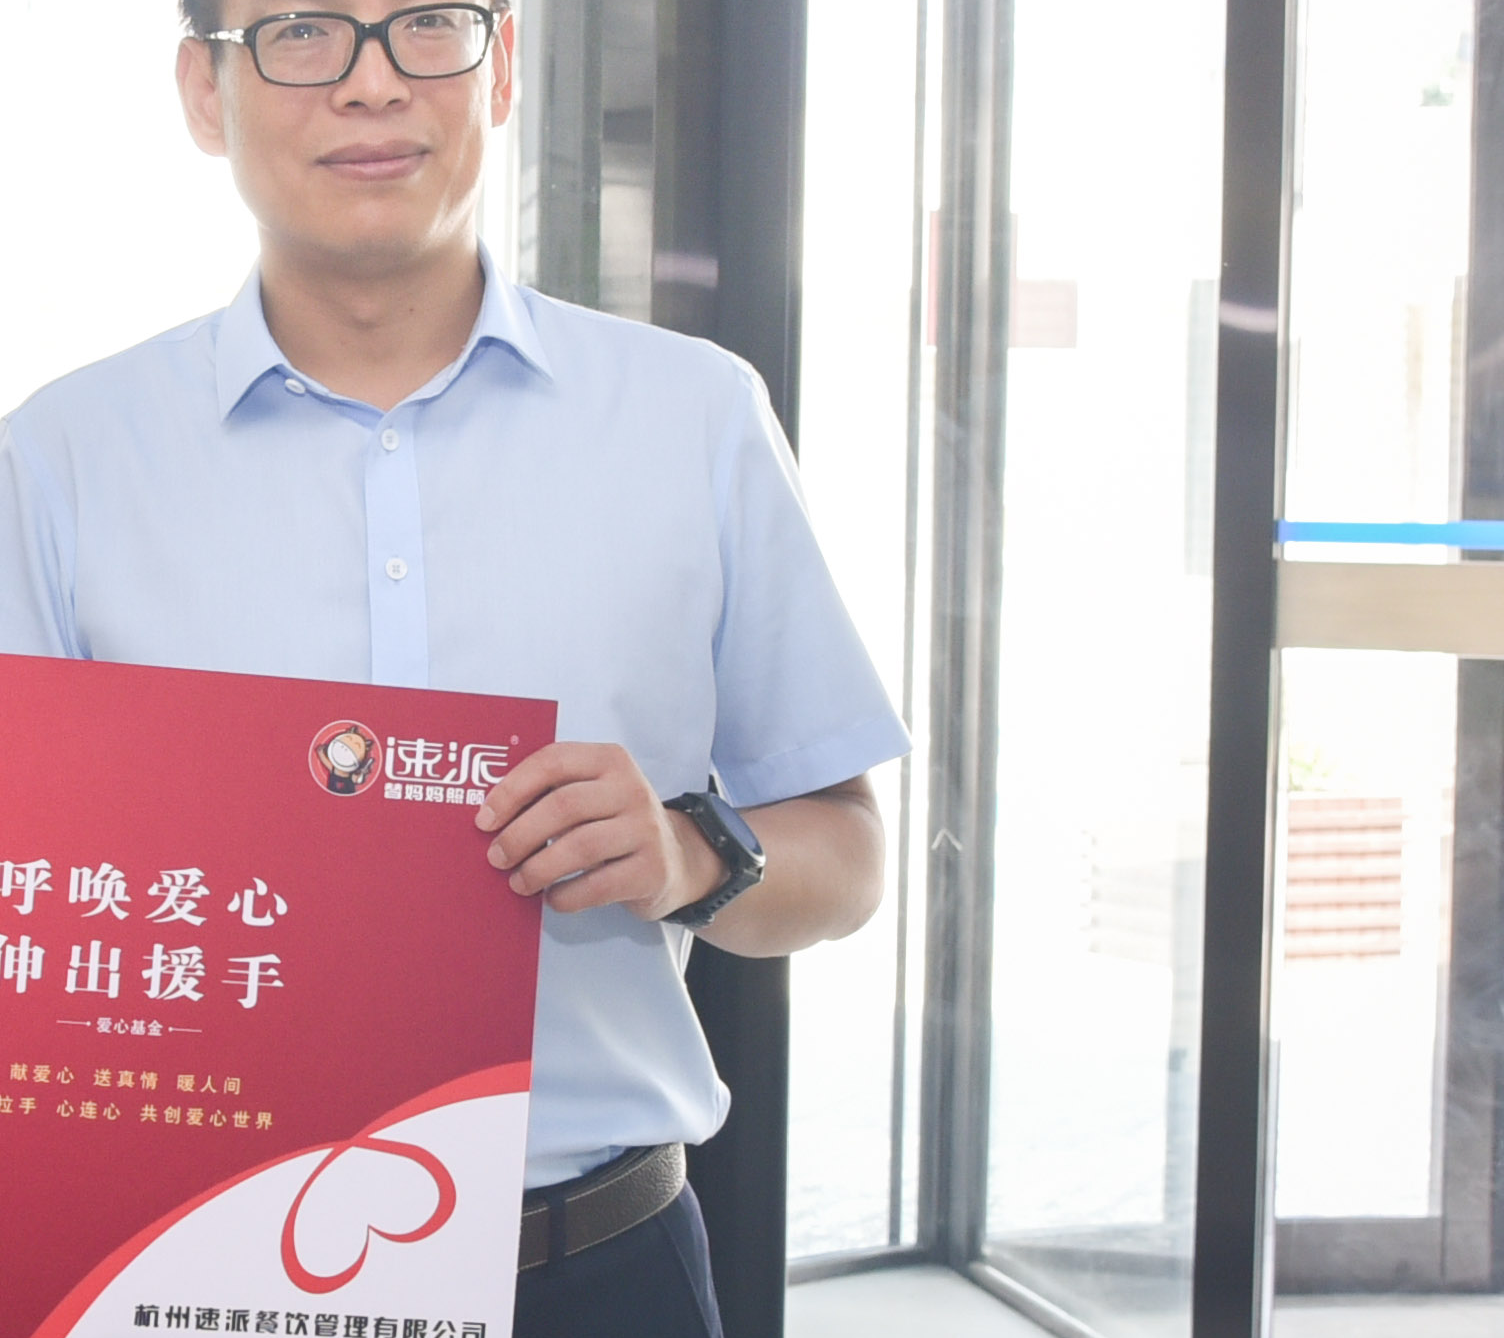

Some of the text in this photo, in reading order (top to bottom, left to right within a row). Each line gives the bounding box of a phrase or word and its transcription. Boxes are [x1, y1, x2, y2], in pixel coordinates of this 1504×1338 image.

[384, 736, 510, 788] 速派
[96, 1017, 164, 1037] 爱心基金
[9, 1062, 242, 1095] 献爱心 送真情 暖人间
[56, 1099, 121, 1120] 心连心
[139, 1103, 274, 1130] 共创爱心世界
